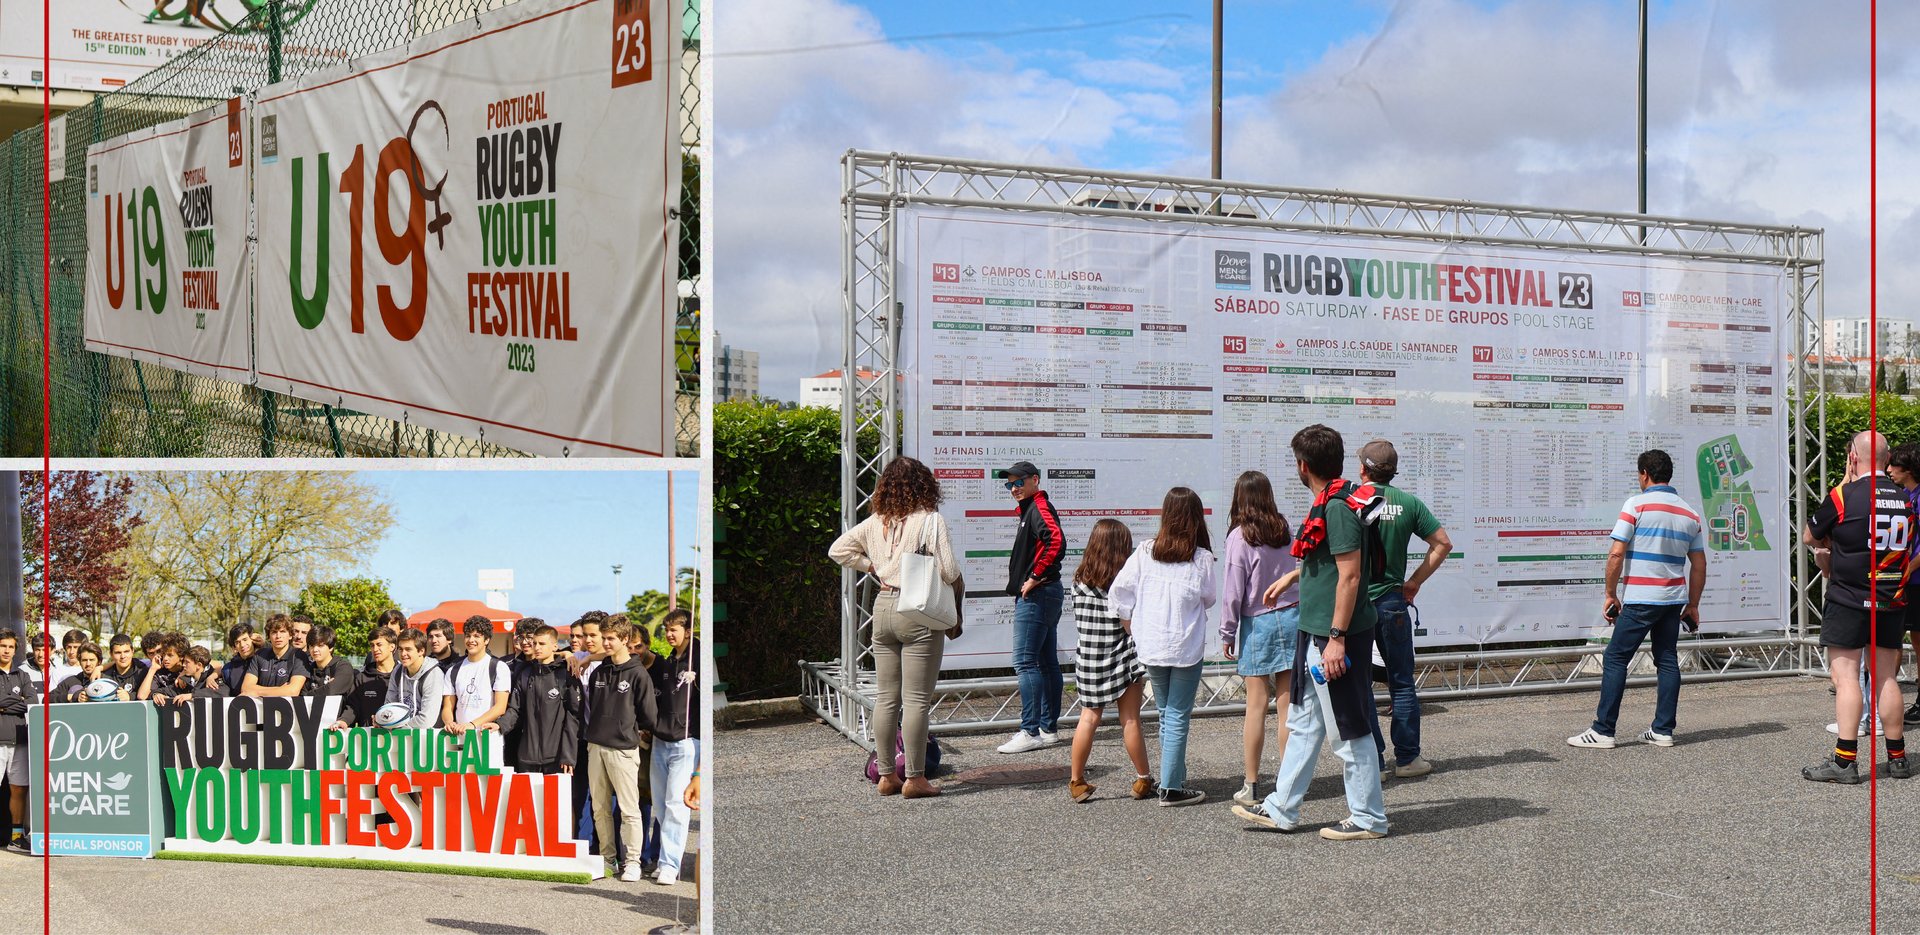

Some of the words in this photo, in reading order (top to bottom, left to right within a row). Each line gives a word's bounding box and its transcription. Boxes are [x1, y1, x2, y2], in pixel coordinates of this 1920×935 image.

[72, 29, 91, 40] THE
[94, 31, 144, 43] GREATEST
[146, 35, 178, 46] RUGBY
[85, 43, 105, 52] 15TH
[108, 44, 146, 56] EDITION
[616, 19, 646, 74] 23
[487, 91, 548, 130] PORTUGAL
[230, 132, 241, 160] 23
[476, 122, 562, 200] RUGBY
[184, 166, 208, 188] PORTUGAL
[180, 185, 214, 228] RUGBY
[289, 137, 428, 342] U19
[478, 198, 556, 266] YOUTH
[104, 186, 168, 314] U19
[184, 229, 214, 268] YOUTH
[1220, 254, 1246, 266] Dove
[936, 266, 956, 280] U13
[982, 266, 1030, 278] CAMPOS
[1035, 269, 1102, 282] C.M.LISBOA
[982, 277, 1016, 287] FIELDS
[182, 271, 220, 310] FESTIVAL
[1562, 276, 1590, 306] 23
[1624, 294, 1639, 305] U19
[1659, 293, 1688, 302] CAMPO
[1690, 295, 1711, 304] DOVE
[1714, 296, 1733, 305] MEN
[1742, 298, 1762, 307] CARE
[467, 271, 578, 342] FESTIVAL
[1214, 296, 1280, 314] SÁBADO
[1286, 302, 1368, 319] SATURDAY
[1383, 306, 1420, 322] FASE
[1425, 309, 1444, 322] DE
[1449, 310, 1508, 326] GRUPOS
[1514, 312, 1549, 328] POOL
[1552, 315, 1594, 330] STAGE
[507, 342, 535, 373] 2023
[1225, 338, 1244, 351] U15
[1296, 338, 1338, 349] CAMPOS
[1342, 340, 1392, 351] J.C.SAÚDE
[1402, 342, 1458, 354] SANTANDER
[1296, 348, 1325, 358] FIELDS
[1376, 352, 1422, 360] SANTANDER
[1474, 348, 1490, 360] U17
[1532, 348, 1569, 358] CAMPOS
[1532, 358, 1558, 366] FIELDS
[934, 447, 948, 455] 1/4
[952, 447, 984, 455] FINAIS
[1874, 499, 1906, 509] RENDAN
[1488, 516, 1512, 524] FINAIS
[1868, 514, 1908, 551] 50
[48, 720, 129, 761] Dove
[163, 695, 325, 772] RUGBY
[323, 728, 500, 776] PORTUGAL
[48, 772, 102, 793] MEN
[48, 794, 130, 816] +CARE
[90, 840, 143, 851] SPONSOR
